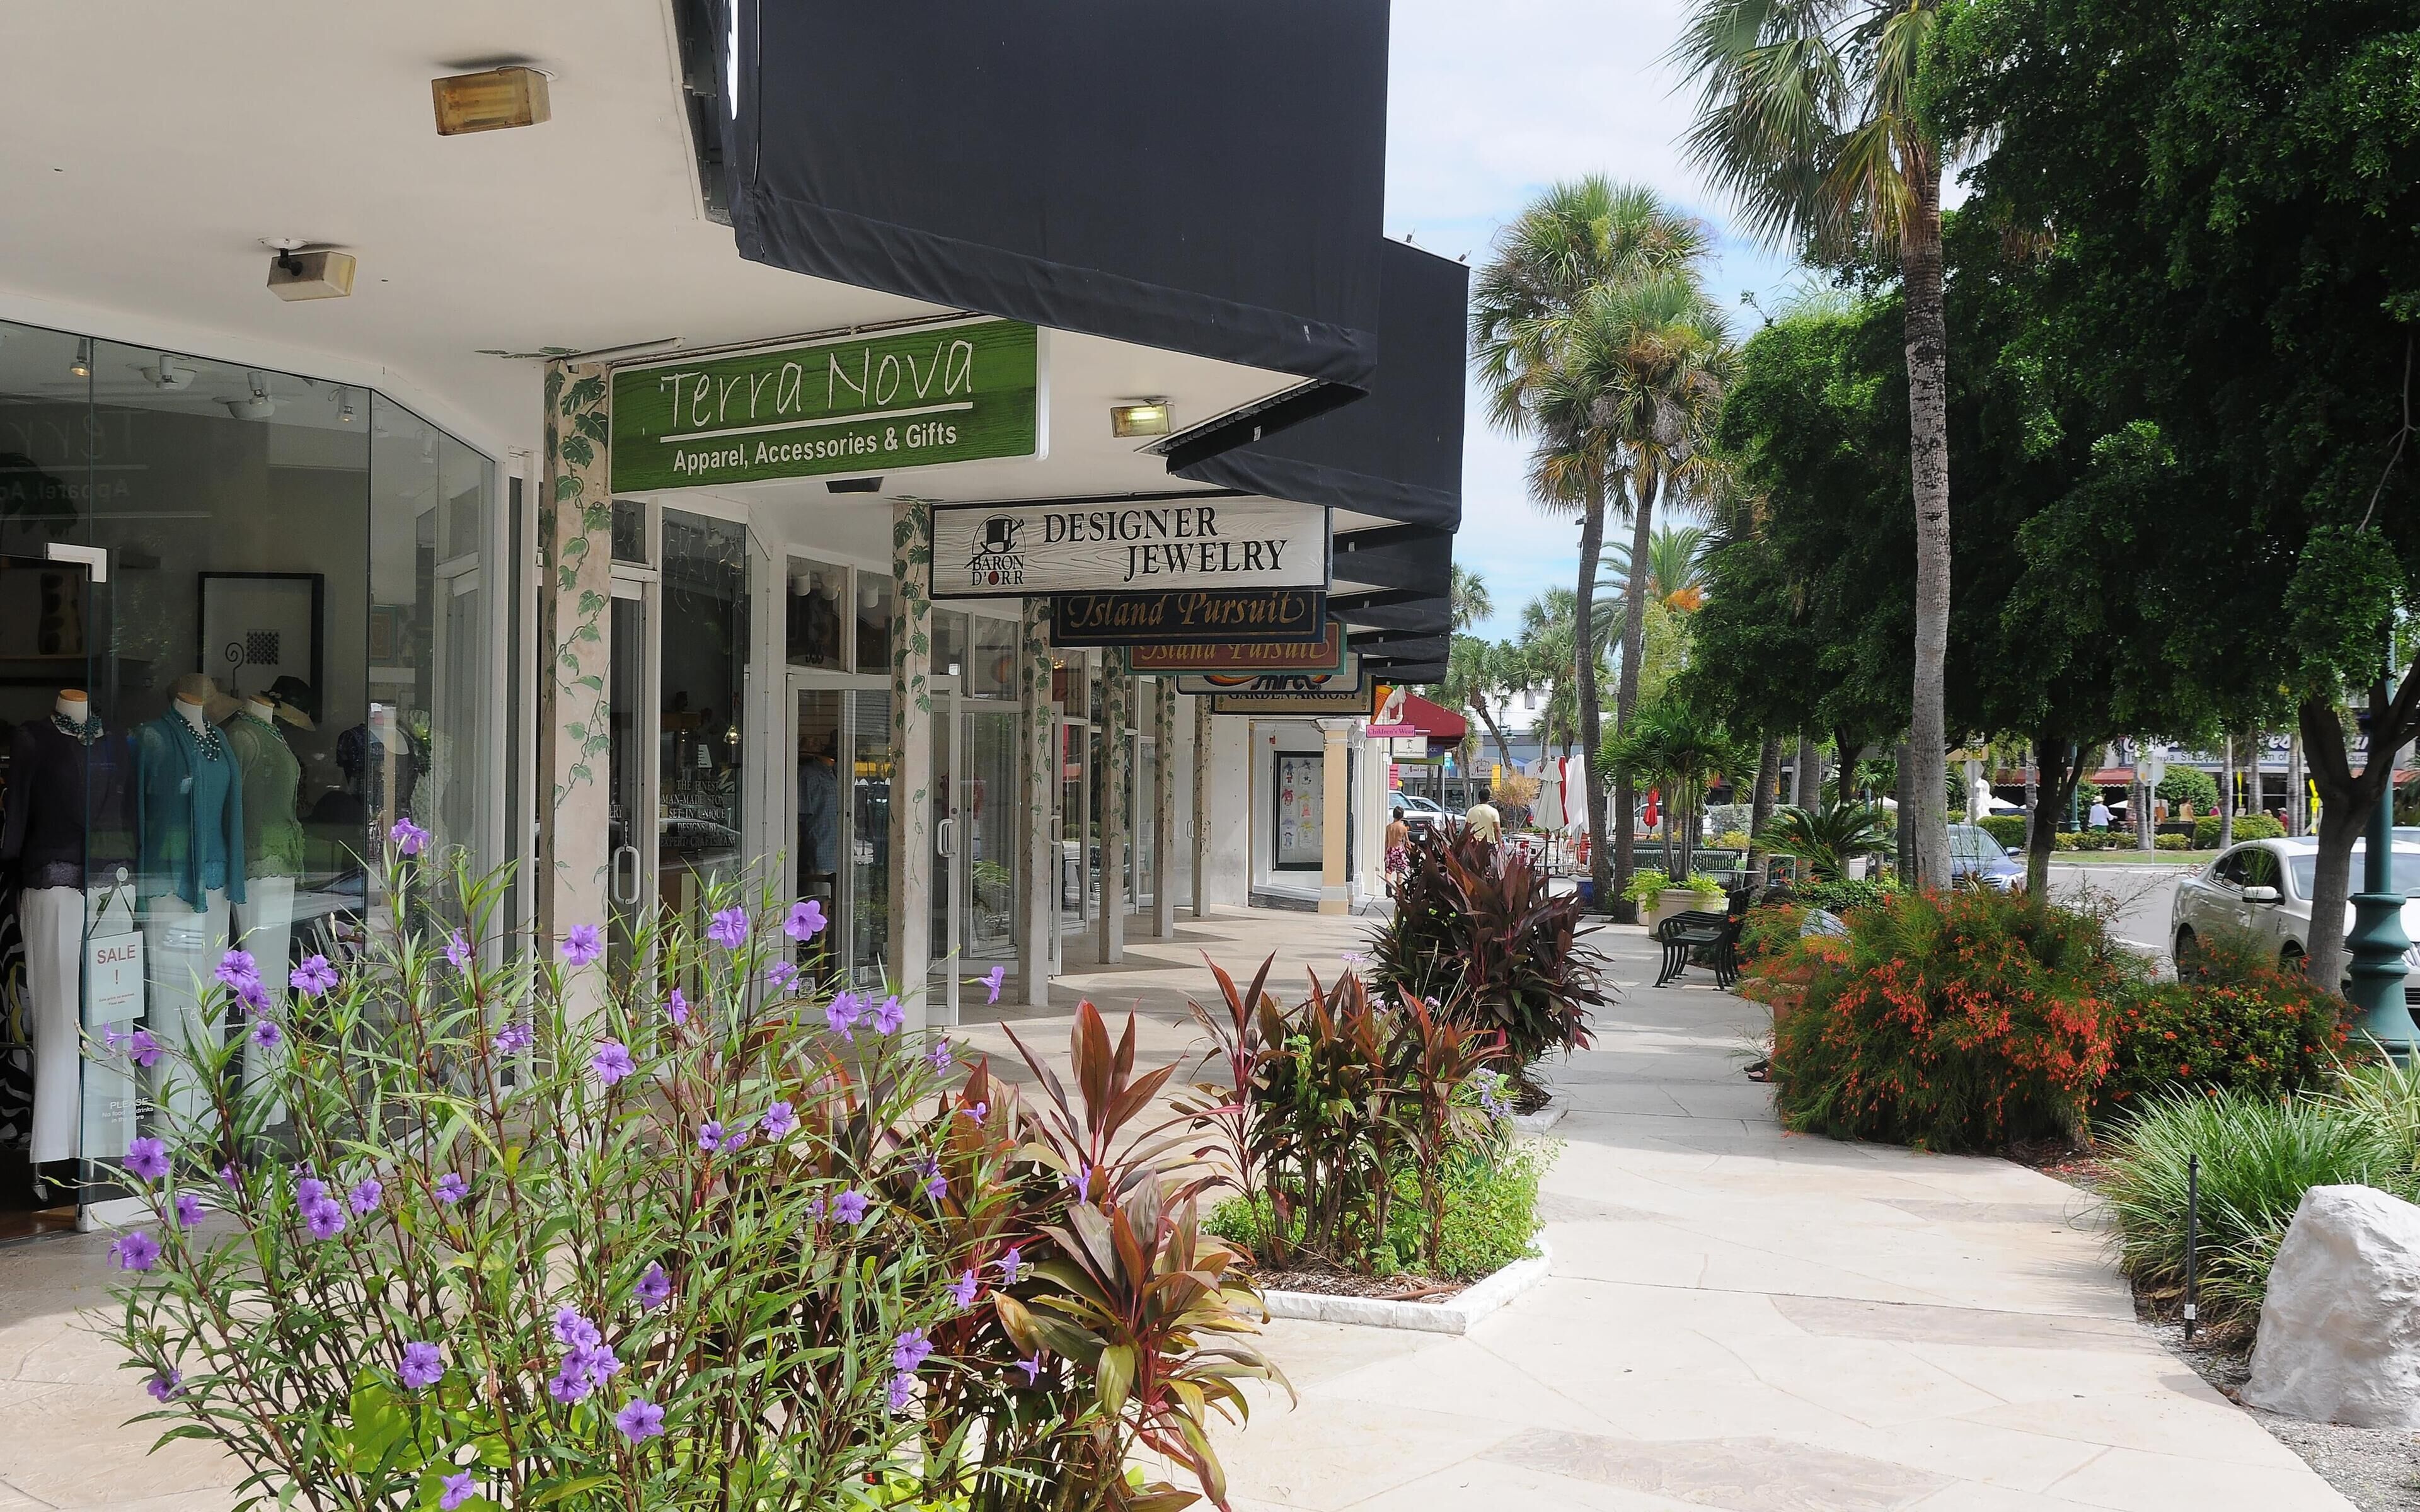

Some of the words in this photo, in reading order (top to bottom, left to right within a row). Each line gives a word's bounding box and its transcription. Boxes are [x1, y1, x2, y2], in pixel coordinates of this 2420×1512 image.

[661, 362, 802, 427] Terra
[828, 340, 973, 409] Nova
[673, 443, 748, 476] Apparel,
[754, 432, 877, 464] Accessories
[884, 427, 898, 451] &
[906, 421, 957, 448] Gifts
[1043, 506, 1218, 544] DESIGNER
[971, 554, 1025, 571] BARON
[1123, 539, 1288, 583] JEWELRY
[1067, 594, 1171, 629] Island
[1177, 592, 1305, 626] Pursuit
[676, 780, 691, 790] THE
[662, 794, 703, 805] MAN-MADE
[669, 808, 681, 818] SET
[686, 808, 694, 818] IN
[677, 822, 706, 832] DESIGNS
[709, 822, 717, 832] BY
[97, 944, 135, 965] SALE
